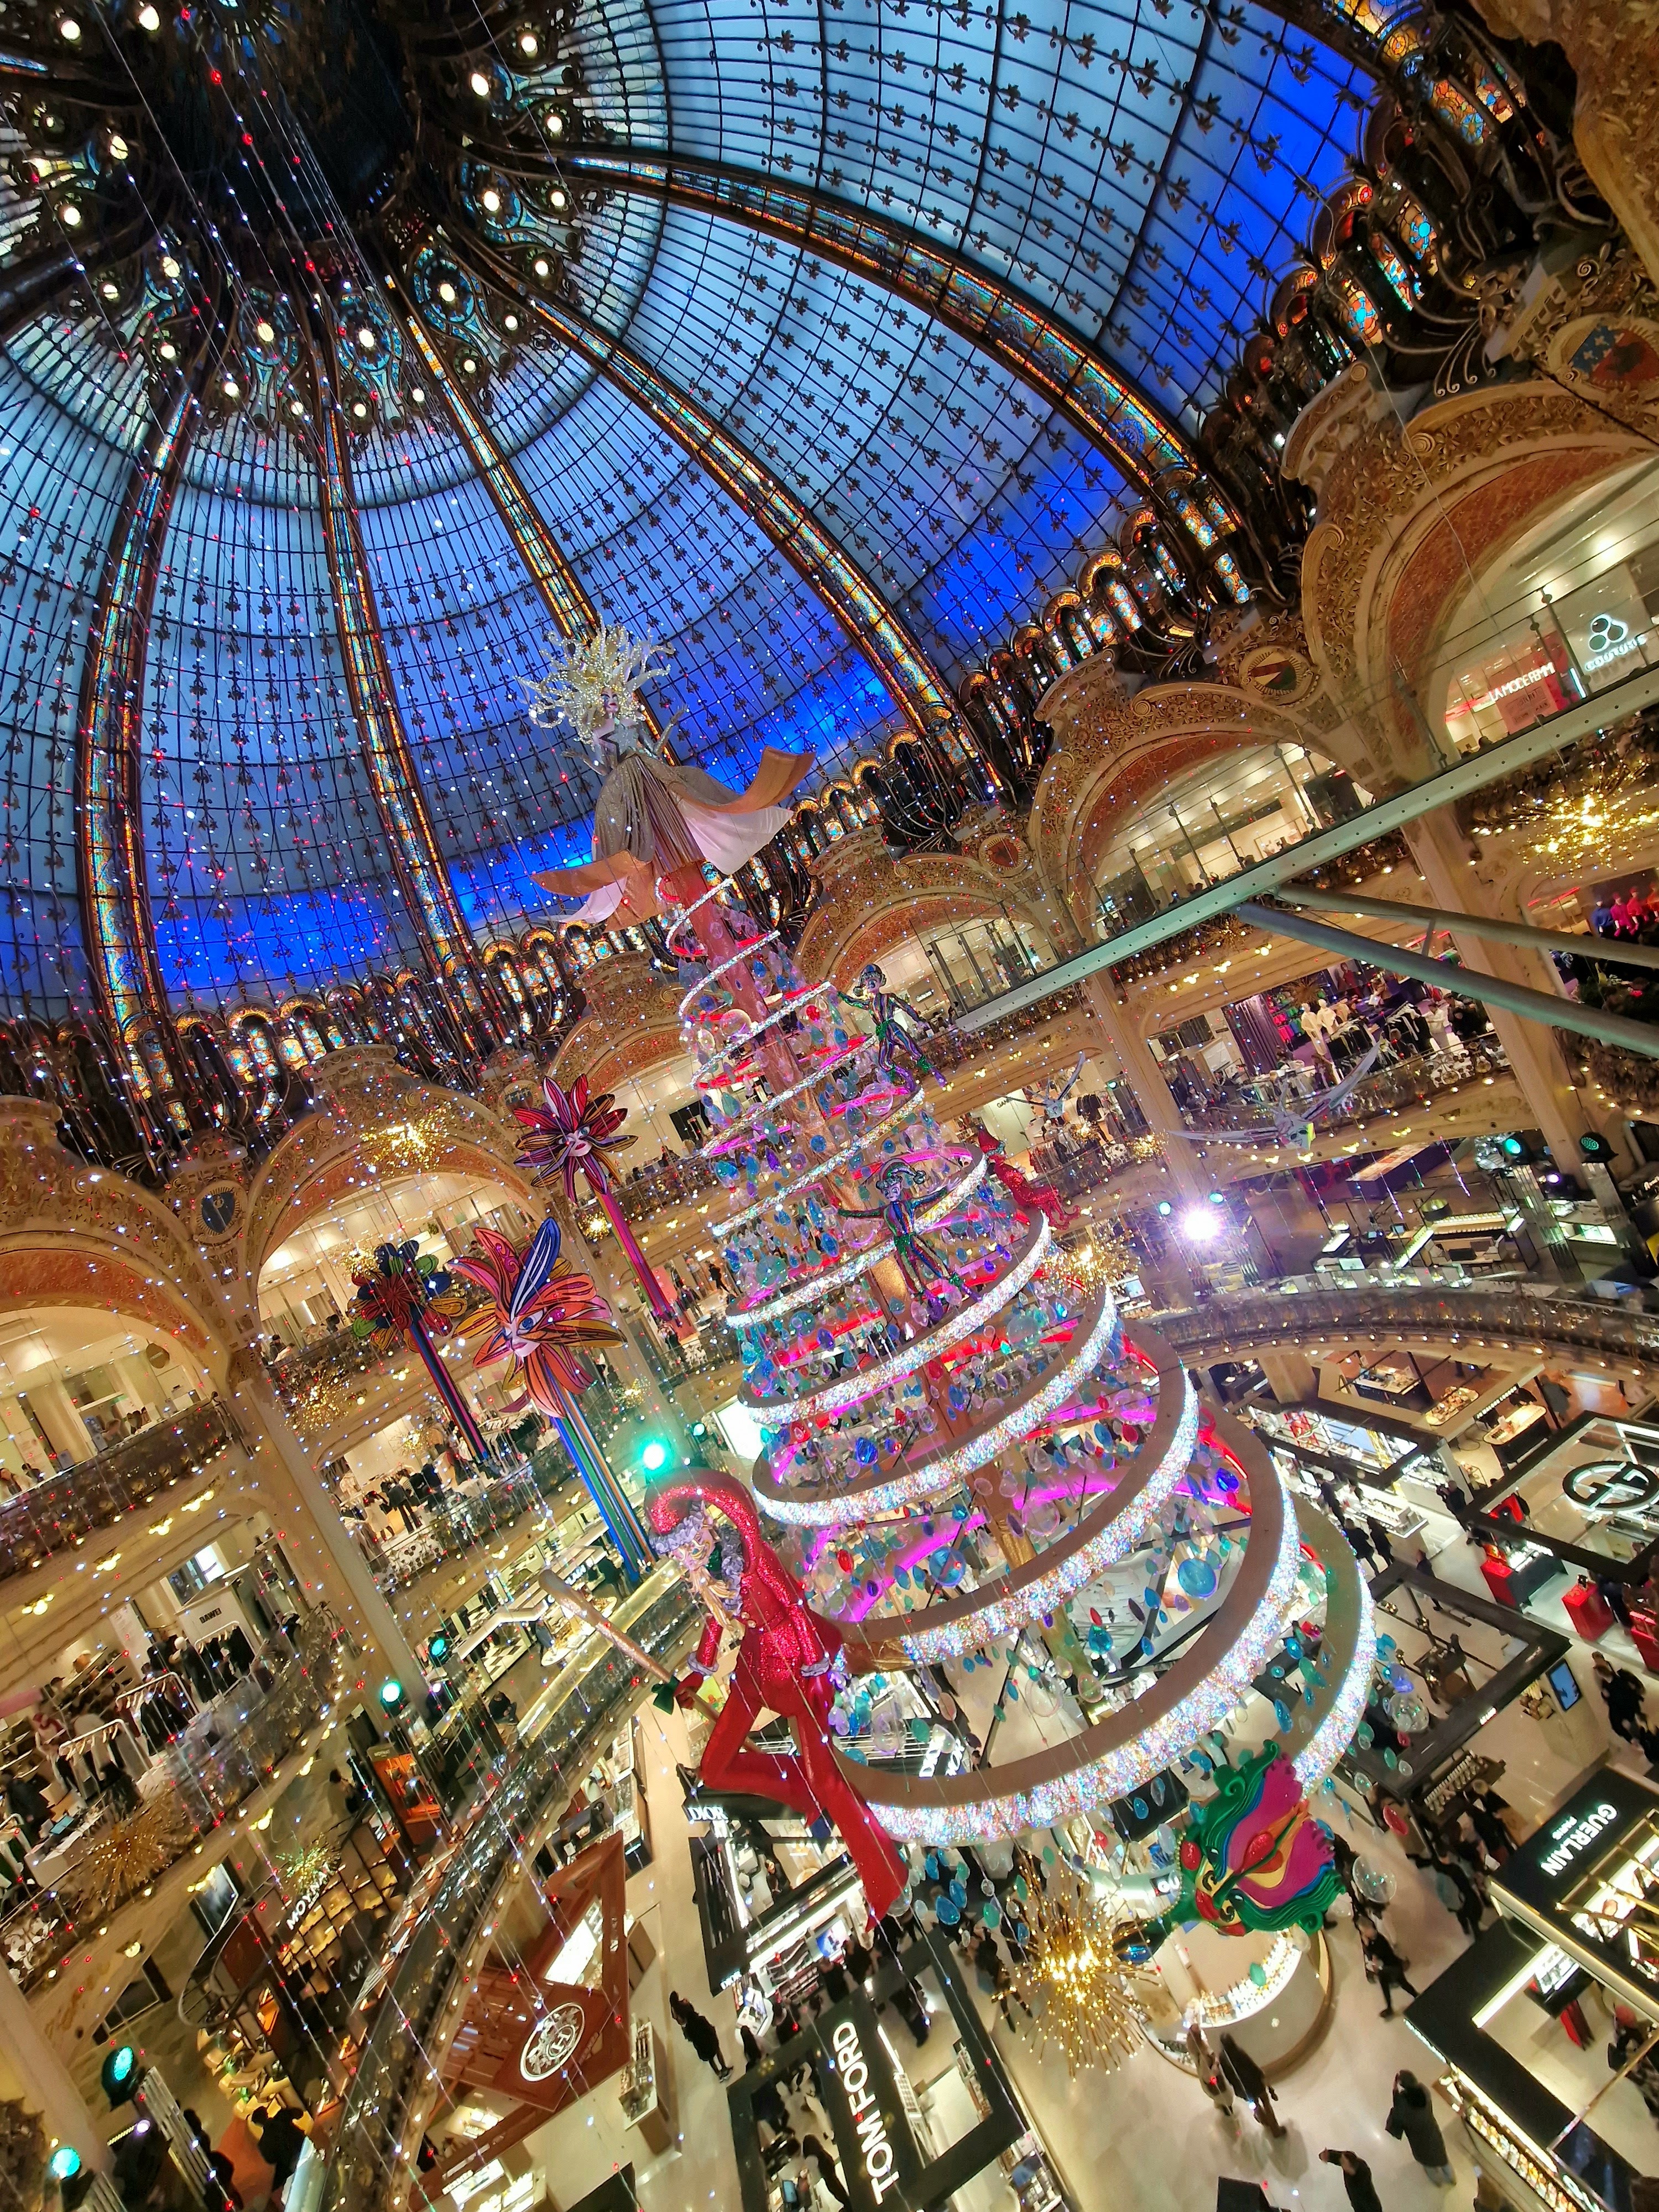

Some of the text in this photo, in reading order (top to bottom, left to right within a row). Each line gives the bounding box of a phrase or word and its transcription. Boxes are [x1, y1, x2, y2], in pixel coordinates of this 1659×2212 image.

[199, 1607, 222, 1624] DAWEI
[687, 1806, 728, 1820] DIOR
[1541, 1804, 1618, 1876] GUERLAIN
[832, 2022, 900, 2205] TOM FORD
